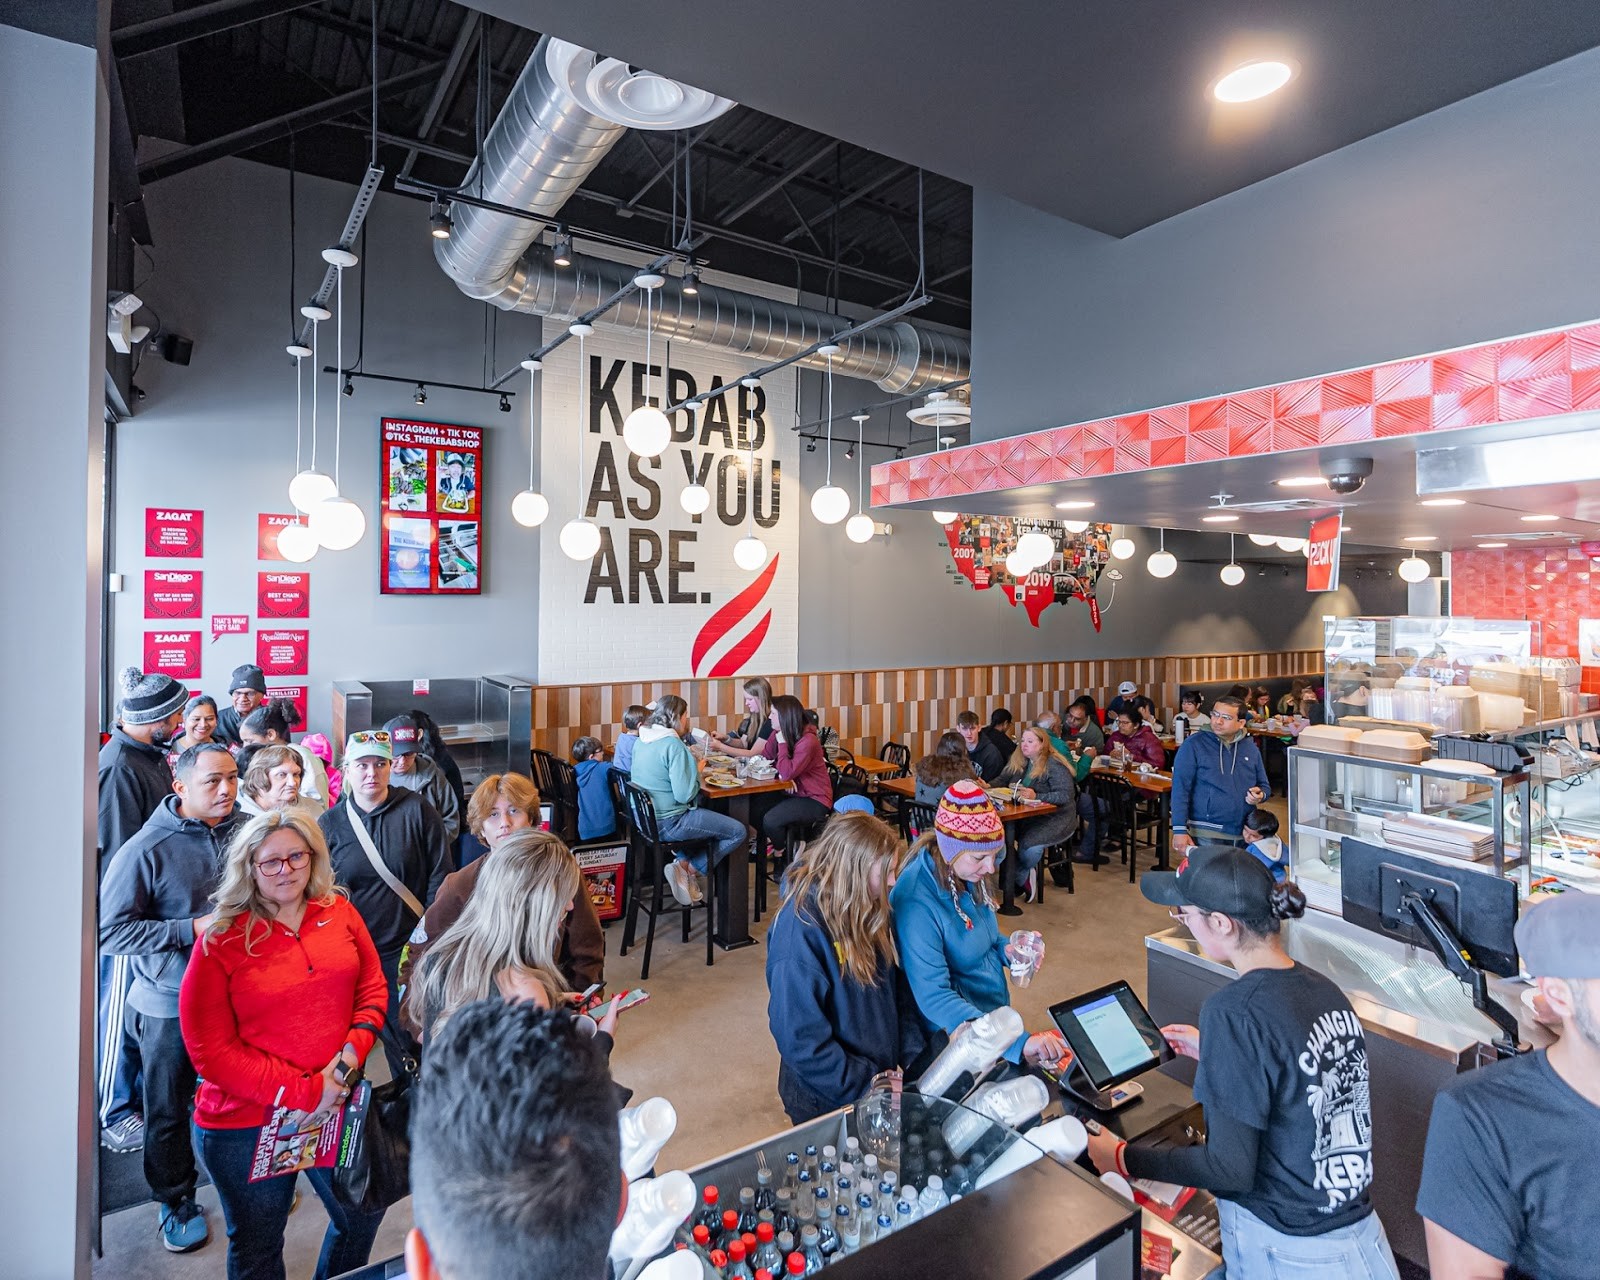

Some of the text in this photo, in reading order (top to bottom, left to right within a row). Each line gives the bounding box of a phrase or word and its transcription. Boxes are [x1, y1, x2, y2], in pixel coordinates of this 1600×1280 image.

[590, 355, 766, 451] KEBAB
[386, 422, 438, 435] INSTAGRAM
[447, 429, 460, 437] TIK
[462, 430, 479, 439] TOK
[386, 433, 479, 448] @TKS_THEKEBABSHOP
[585, 441, 780, 528] AS YOU
[156, 512, 192, 521] ZAGAT
[584, 526, 711, 604] ARE.
[954, 548, 975, 558] 2007
[1025, 571, 1051, 587] 2019
[155, 634, 191, 643] ZAGAT
[252, 1125, 270, 1179] KIDS EAT FREE
[260, 1151, 271, 1176] EVERY
[266, 1136, 276, 1150] SAT
[339, 1125, 352, 1166] nextdoor
